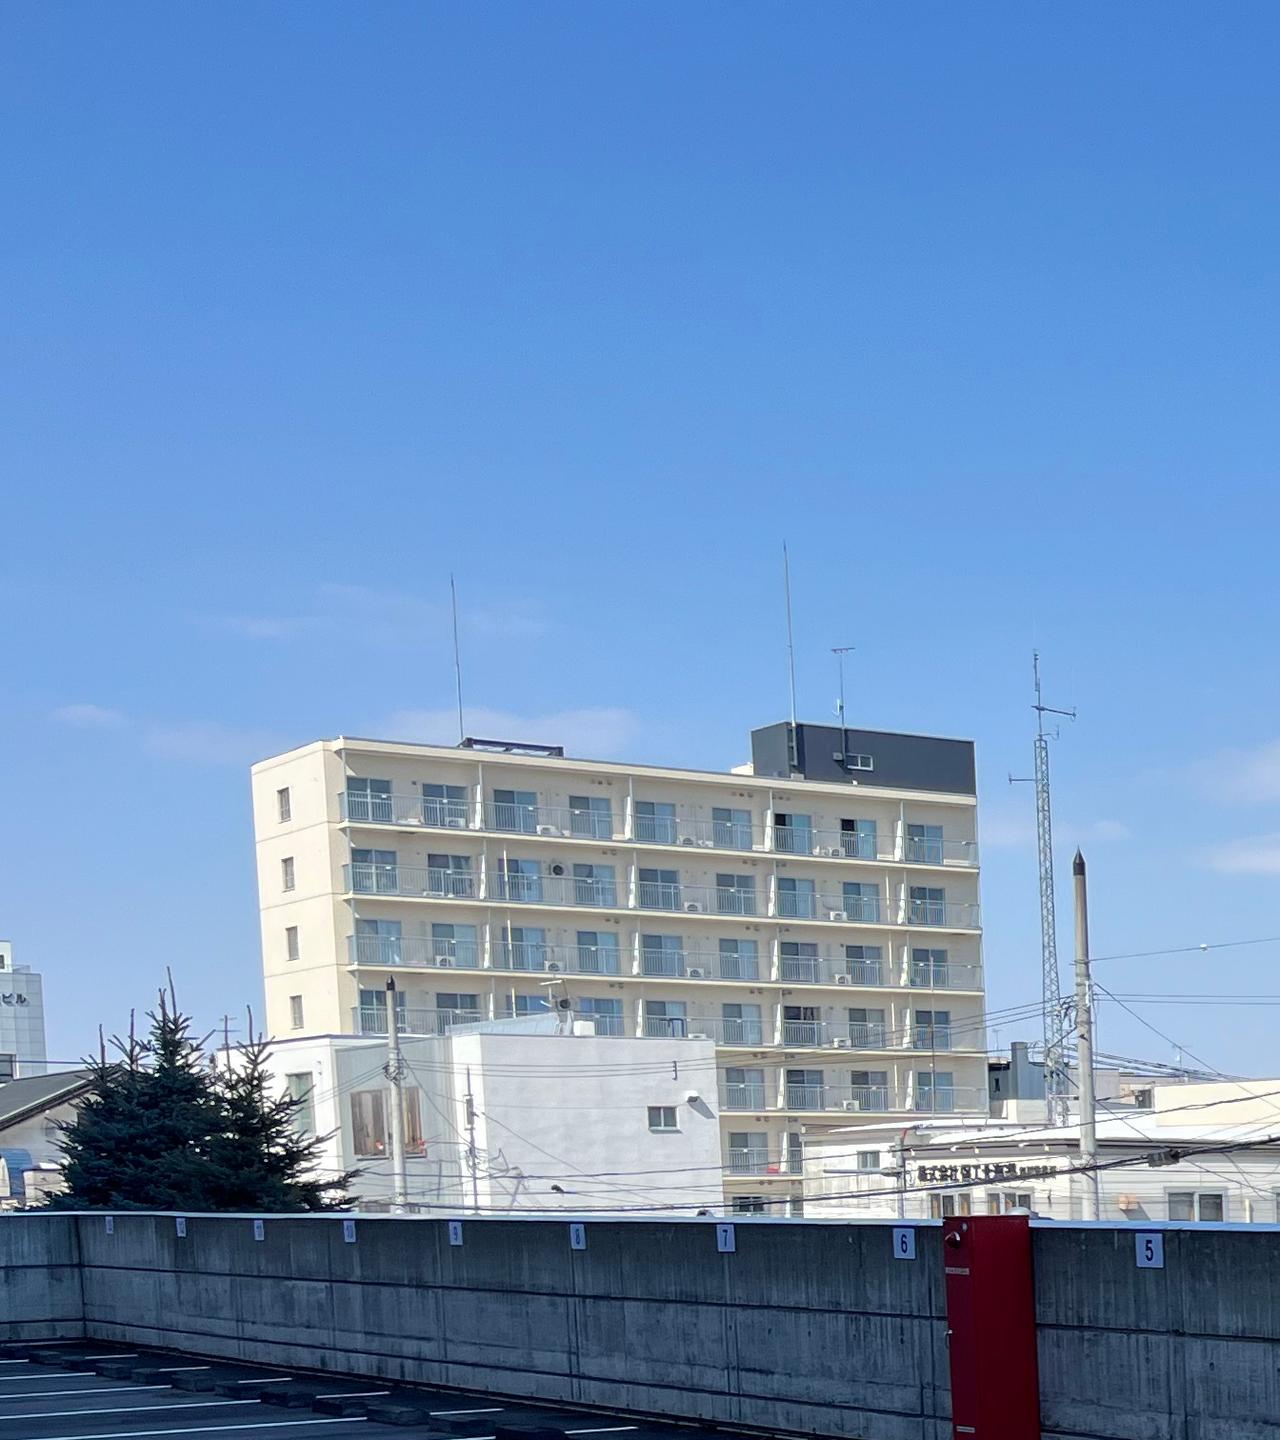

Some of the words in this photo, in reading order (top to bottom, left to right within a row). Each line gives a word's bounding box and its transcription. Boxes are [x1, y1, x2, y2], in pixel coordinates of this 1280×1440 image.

[0, 993, 28, 1005] ビル
[722, 1229, 729, 1248] 7
[901, 1234, 908, 1254] 6
[1145, 1239, 1154, 1262] 5
